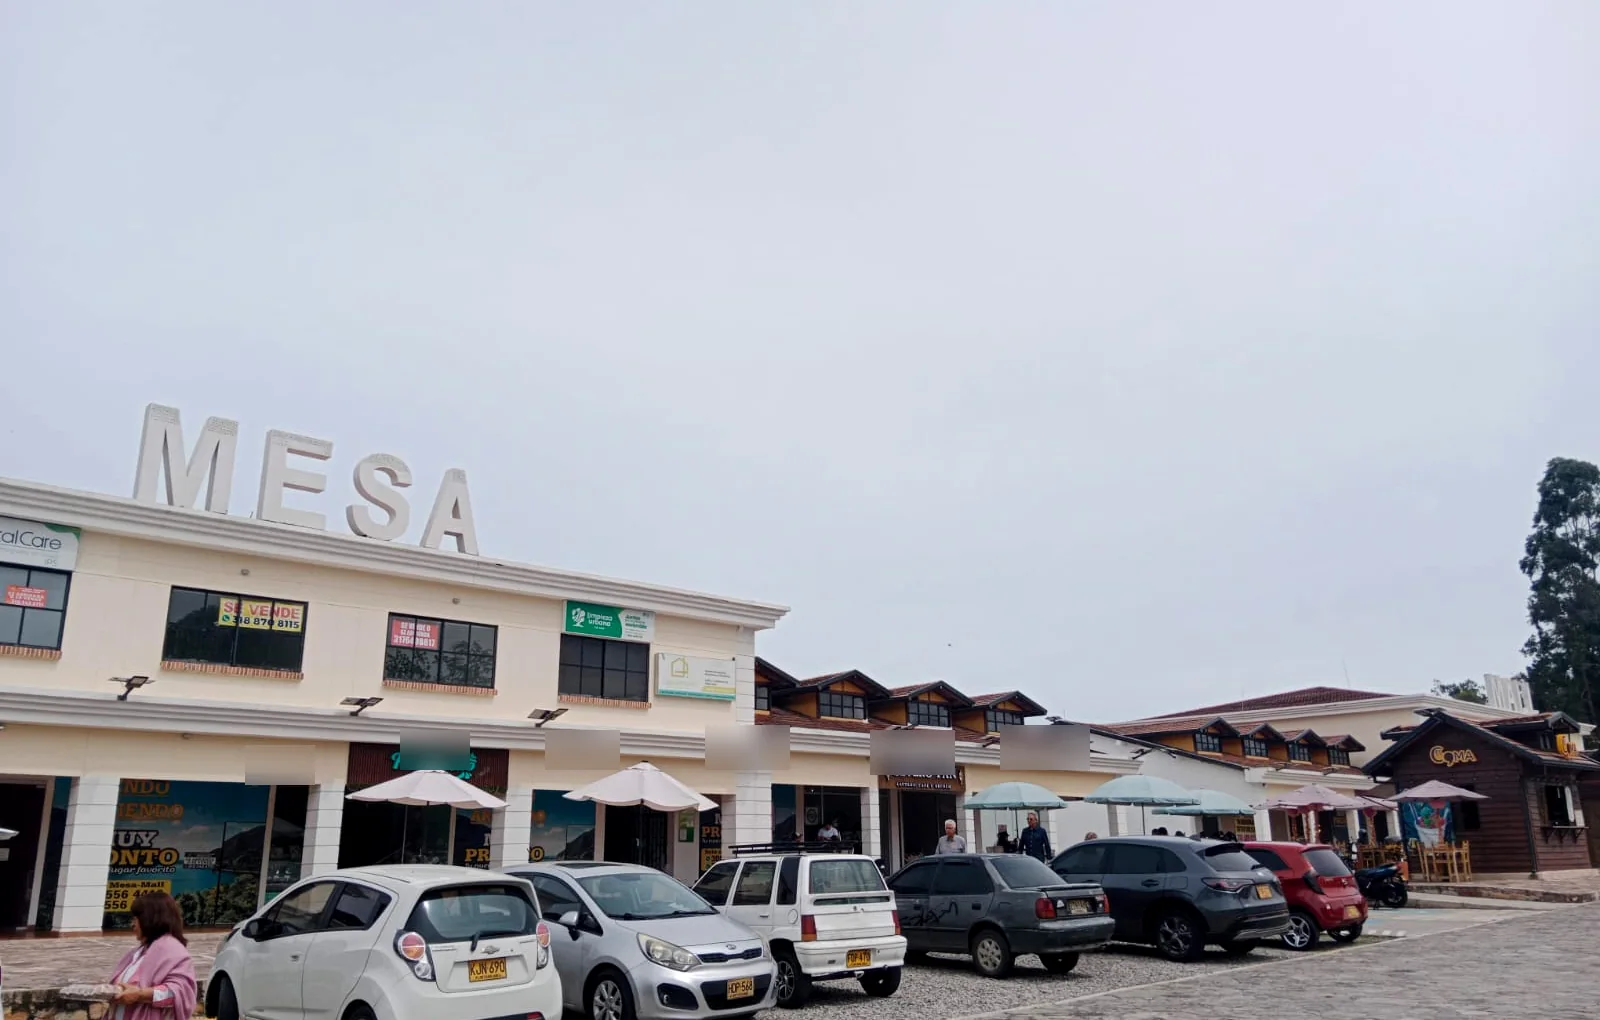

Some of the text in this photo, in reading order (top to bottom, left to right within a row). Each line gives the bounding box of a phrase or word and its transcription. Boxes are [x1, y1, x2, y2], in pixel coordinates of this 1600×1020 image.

[133, 403, 479, 556] MESA
[0, 530, 62, 550] alCare
[249, 604, 301, 619] VENDE
[277, 619, 300, 629] 8115
[122, 780, 171, 795] NDO
[117, 803, 184, 819] IENDO
[111, 831, 157, 847] UY
[110, 866, 177, 875] ugar favorito
[470, 960, 505, 975] KJN 690
